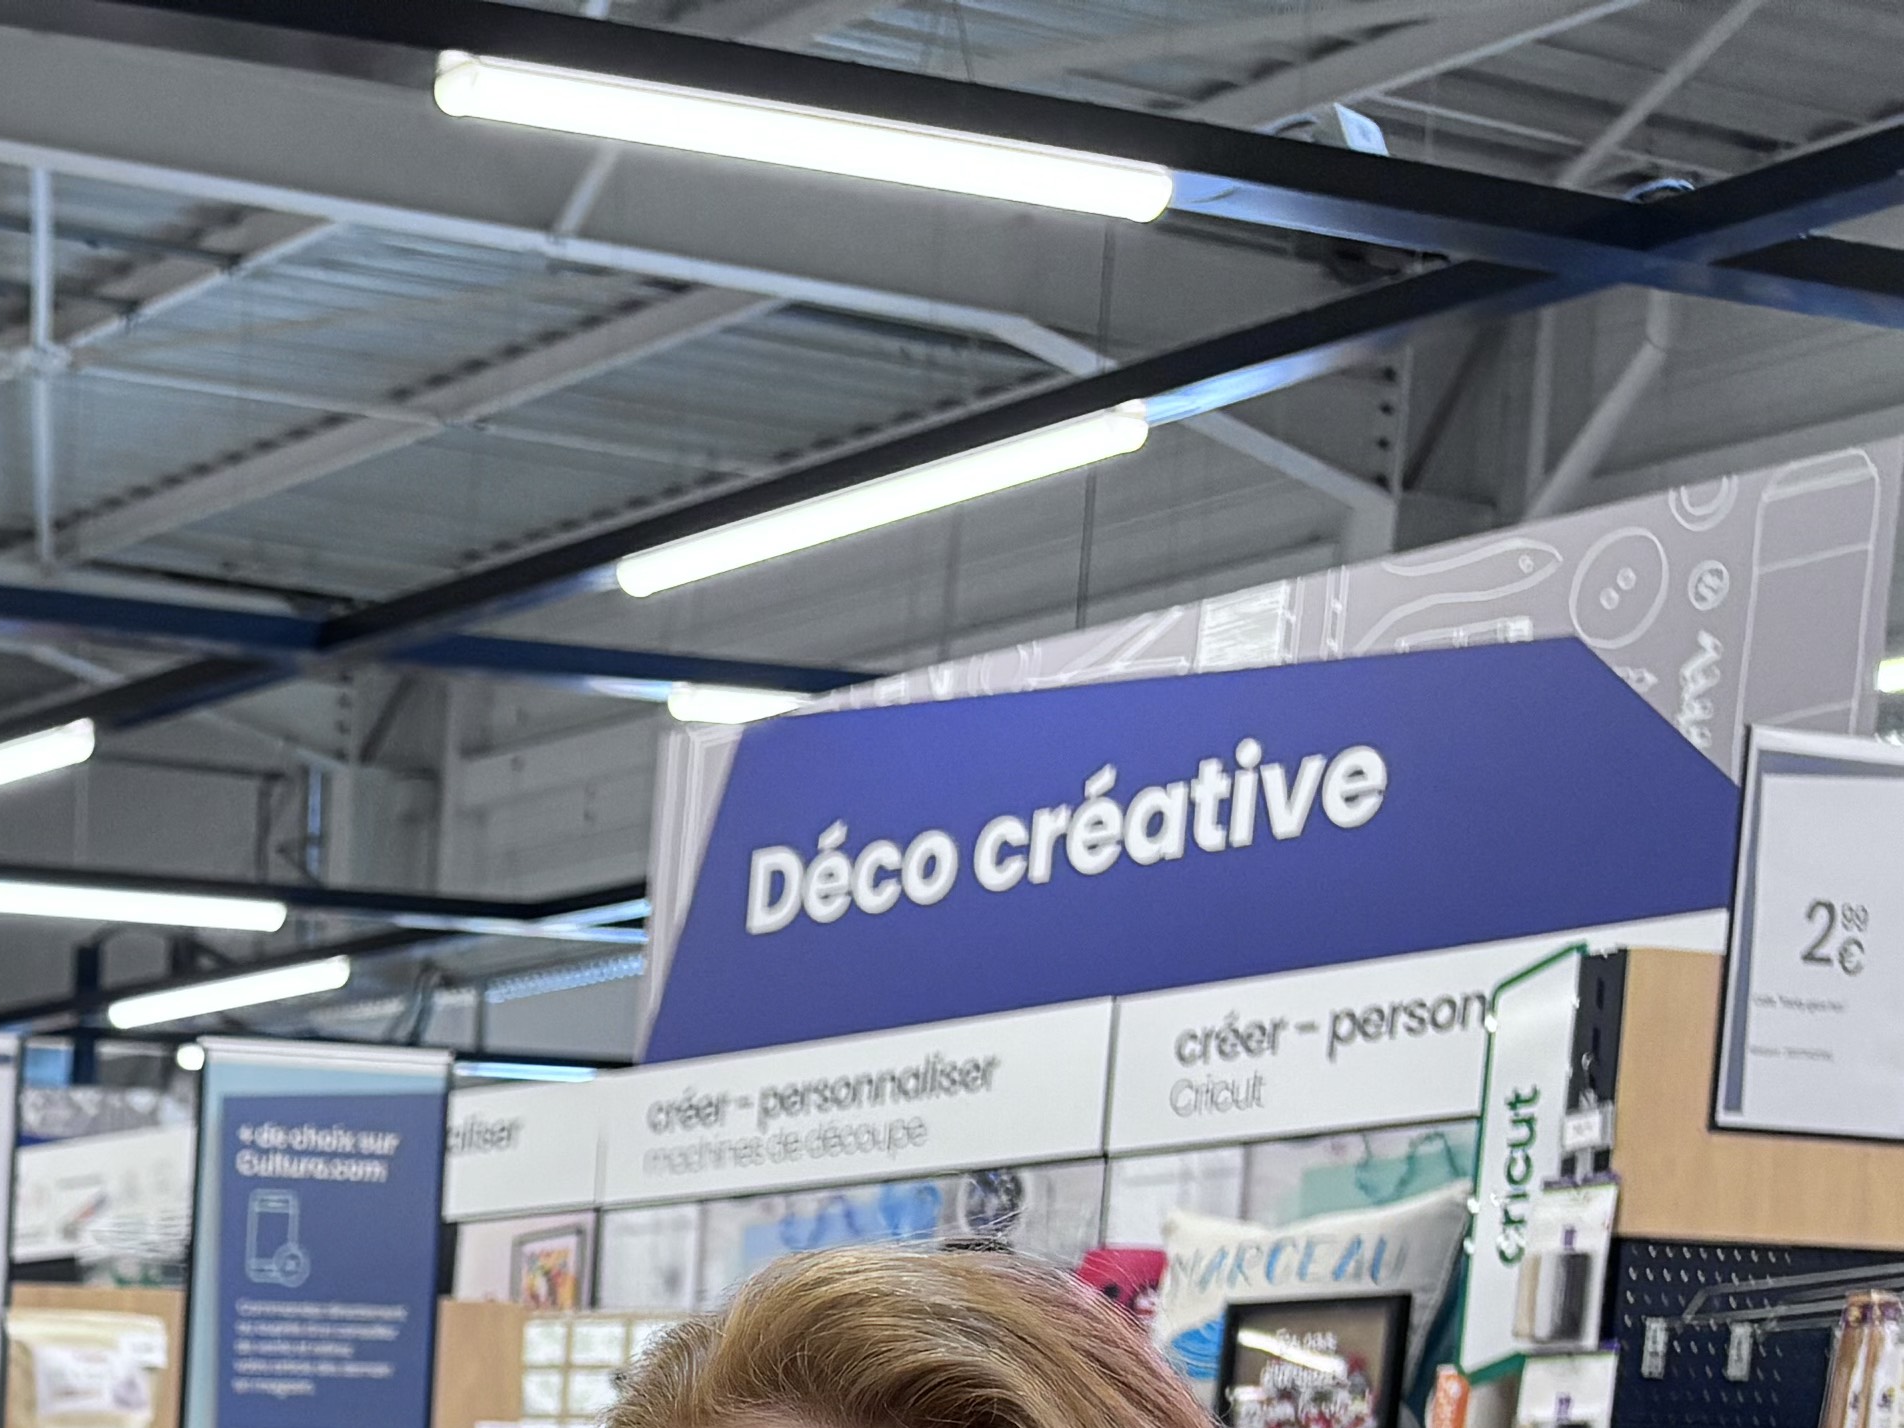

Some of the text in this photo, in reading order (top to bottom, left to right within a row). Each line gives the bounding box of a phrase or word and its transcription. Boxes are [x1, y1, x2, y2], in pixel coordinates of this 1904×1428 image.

[745, 737, 1388, 936] Déco créative
[1801, 899, 1837, 967] 2
[1838, 937, 1866, 976] €
[1175, 1010, 1288, 1067] créer
[1329, 990, 1490, 1062] person
[646, 1086, 730, 1134] créer
[757, 1052, 1002, 1132] personnaliser
[1170, 1071, 1266, 1117] Cricut
[236, 1149, 390, 1182] Cultura.com
[449, 1116, 524, 1151] aliser
[804, 1117, 930, 1160] découpe
[1496, 1085, 1540, 1267] cricut
